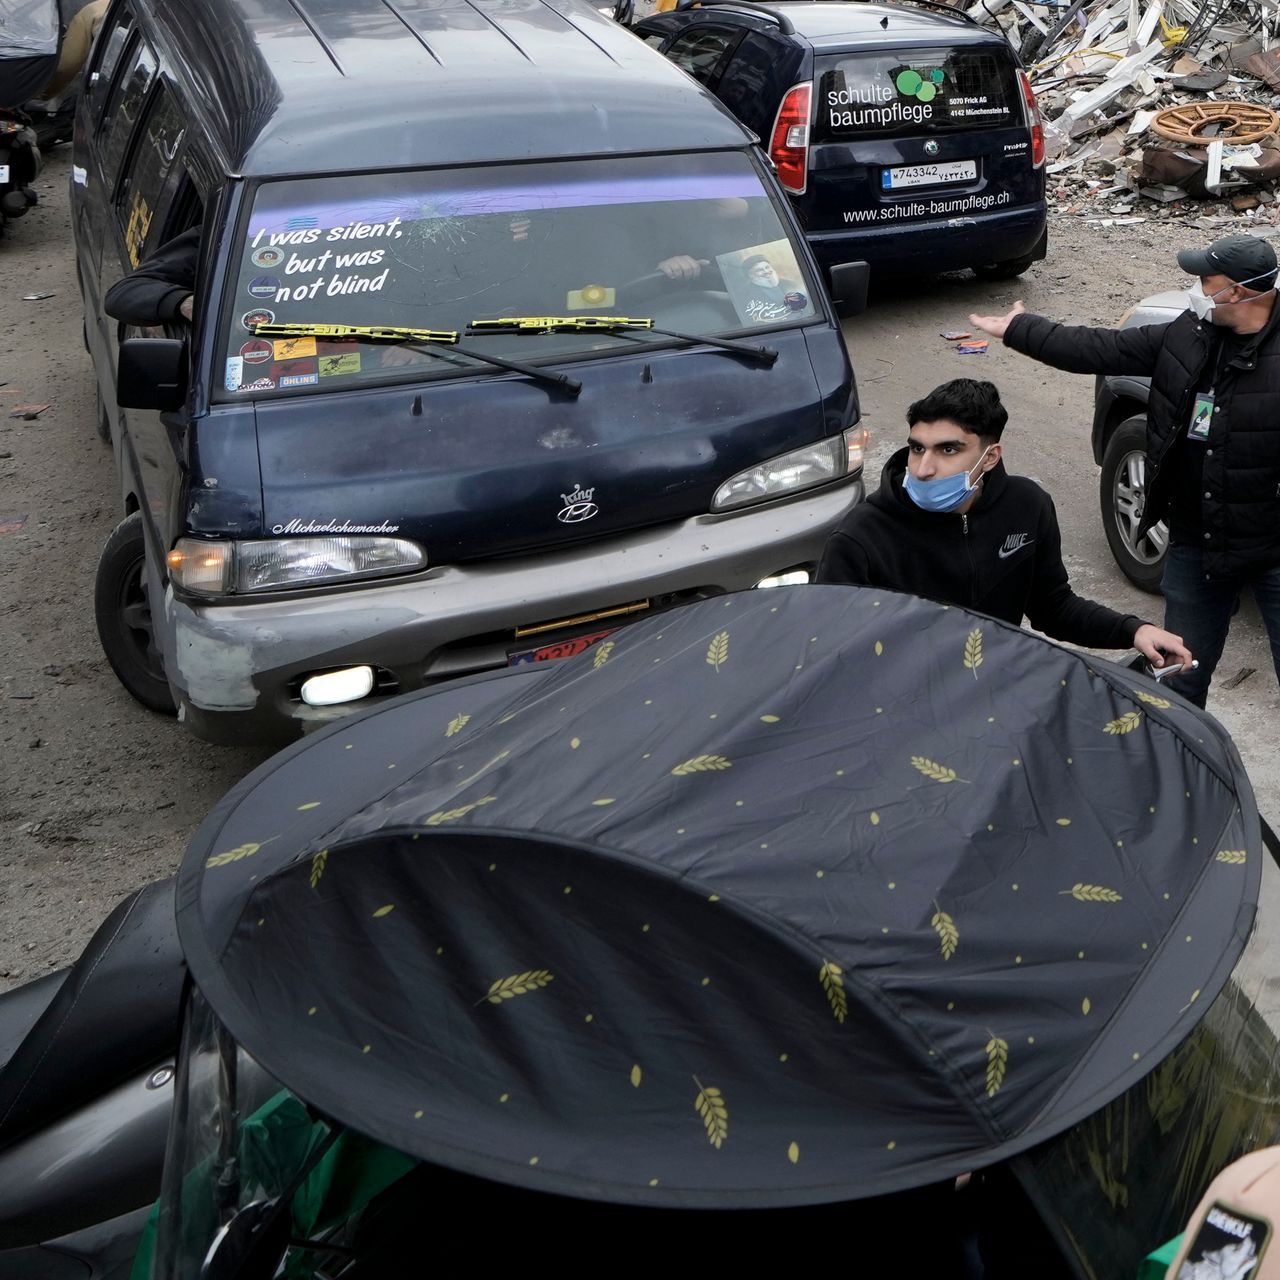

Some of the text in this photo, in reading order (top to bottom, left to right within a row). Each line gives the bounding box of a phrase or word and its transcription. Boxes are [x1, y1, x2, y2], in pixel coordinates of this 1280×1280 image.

[828, 84, 892, 106] schulte
[949, 97, 964, 105] 5070
[964, 96, 979, 104] Frick
[830, 103, 933, 127] baumpflege
[843, 191, 1010, 222] www.schulte-baumpflege.ch
[251, 217, 403, 248] I was silent,
[285, 250, 332, 275] but
[335, 249, 385, 269] was
[275, 269, 389, 303] not blind
[272, 518, 399, 535] Michaelschumacher
[1004, 533, 1028, 549] NIKE
